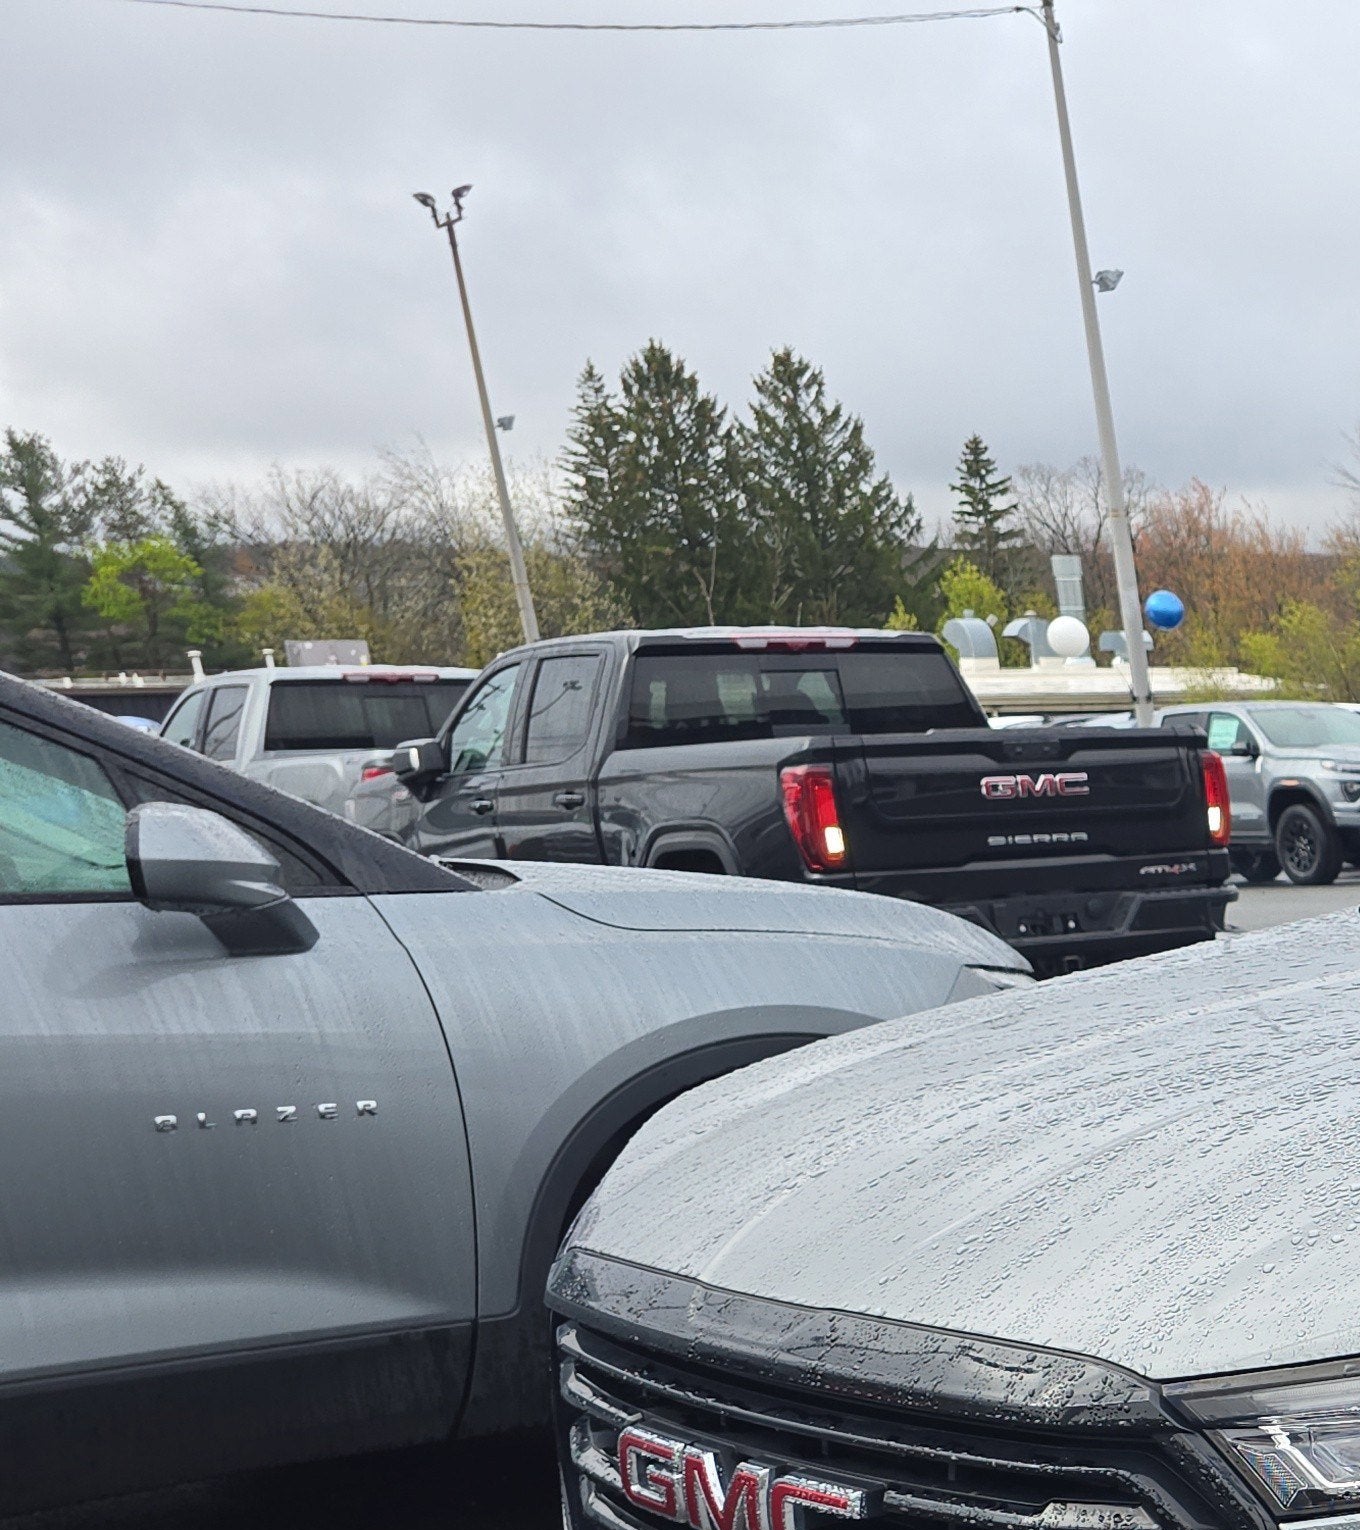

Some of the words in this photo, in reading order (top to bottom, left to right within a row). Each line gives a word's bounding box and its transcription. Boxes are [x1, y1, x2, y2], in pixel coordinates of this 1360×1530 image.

[980, 772, 1090, 799] GMC
[987, 832, 1088, 846] SIERRA
[154, 1100, 379, 1132] BLAZER
